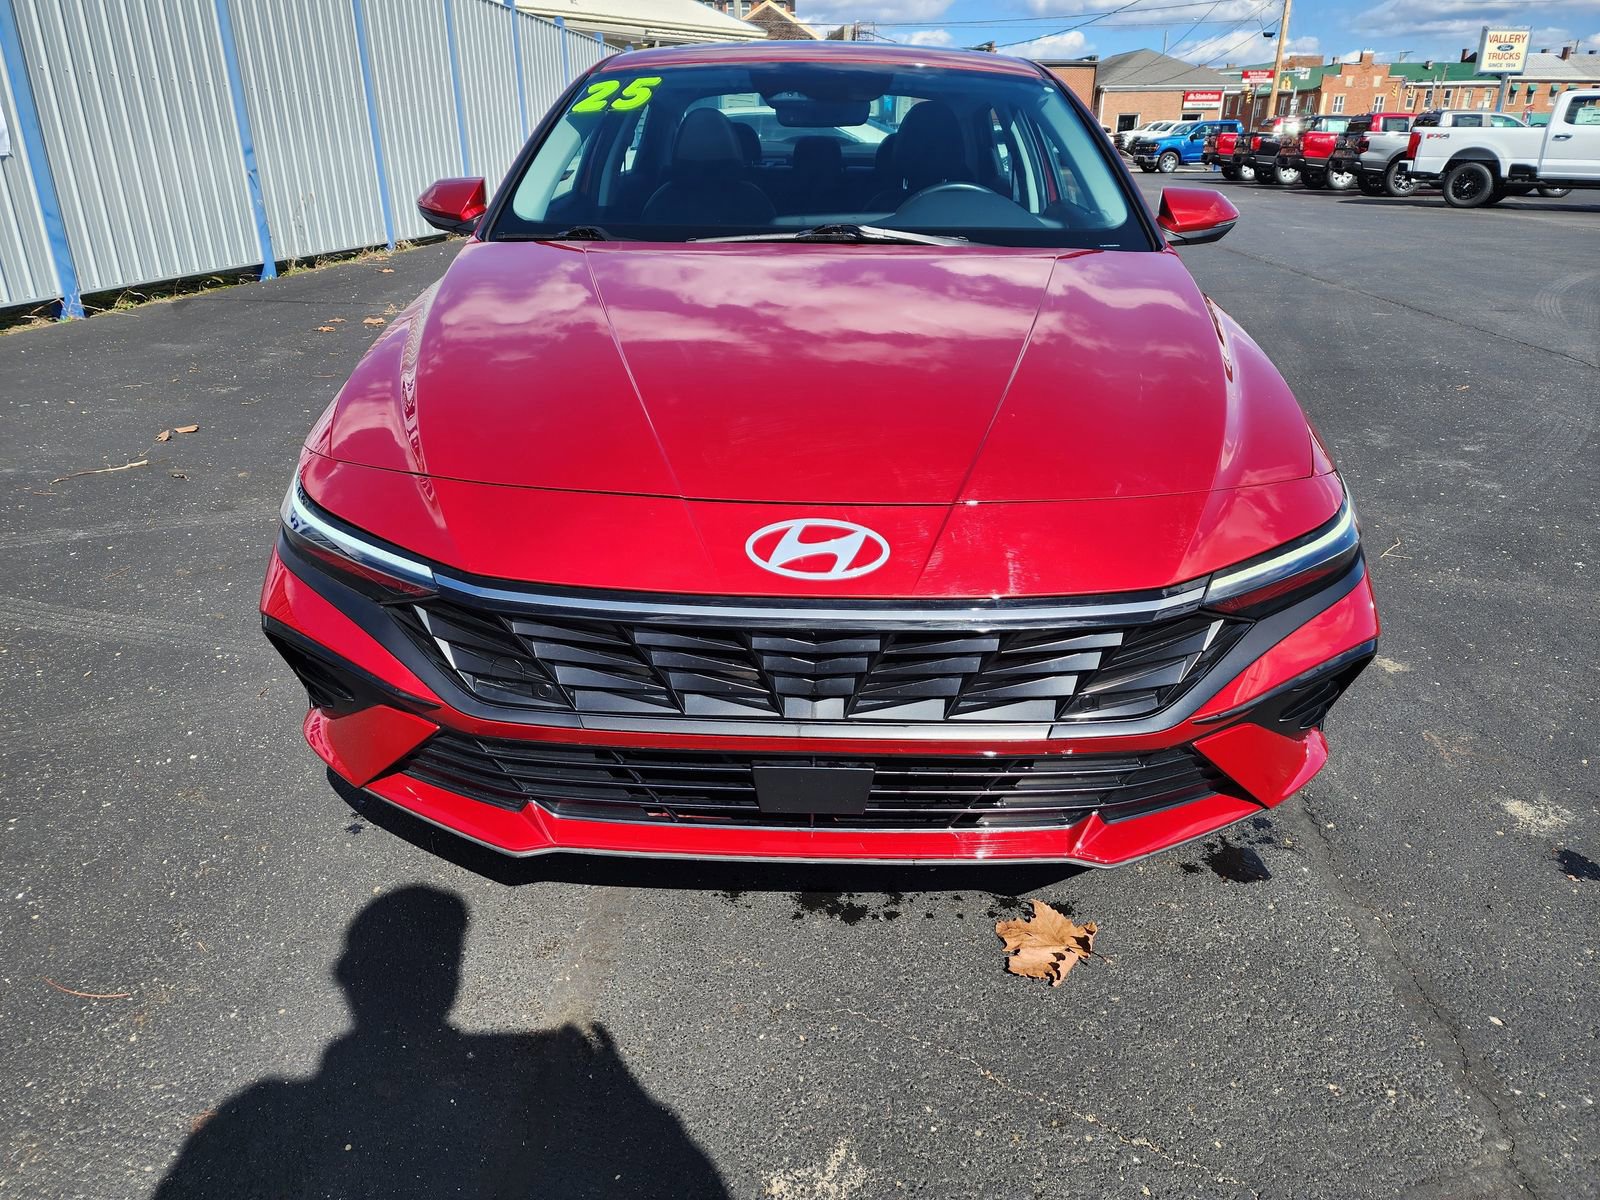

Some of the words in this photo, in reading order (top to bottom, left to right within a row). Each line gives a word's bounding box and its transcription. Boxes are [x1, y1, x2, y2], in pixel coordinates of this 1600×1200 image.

[1488, 34, 1527, 43] VALLERY
[1488, 52, 1521, 60] TRUCKS
[571, 76, 662, 112] 25
[1426, 132, 1450, 140] FX4
